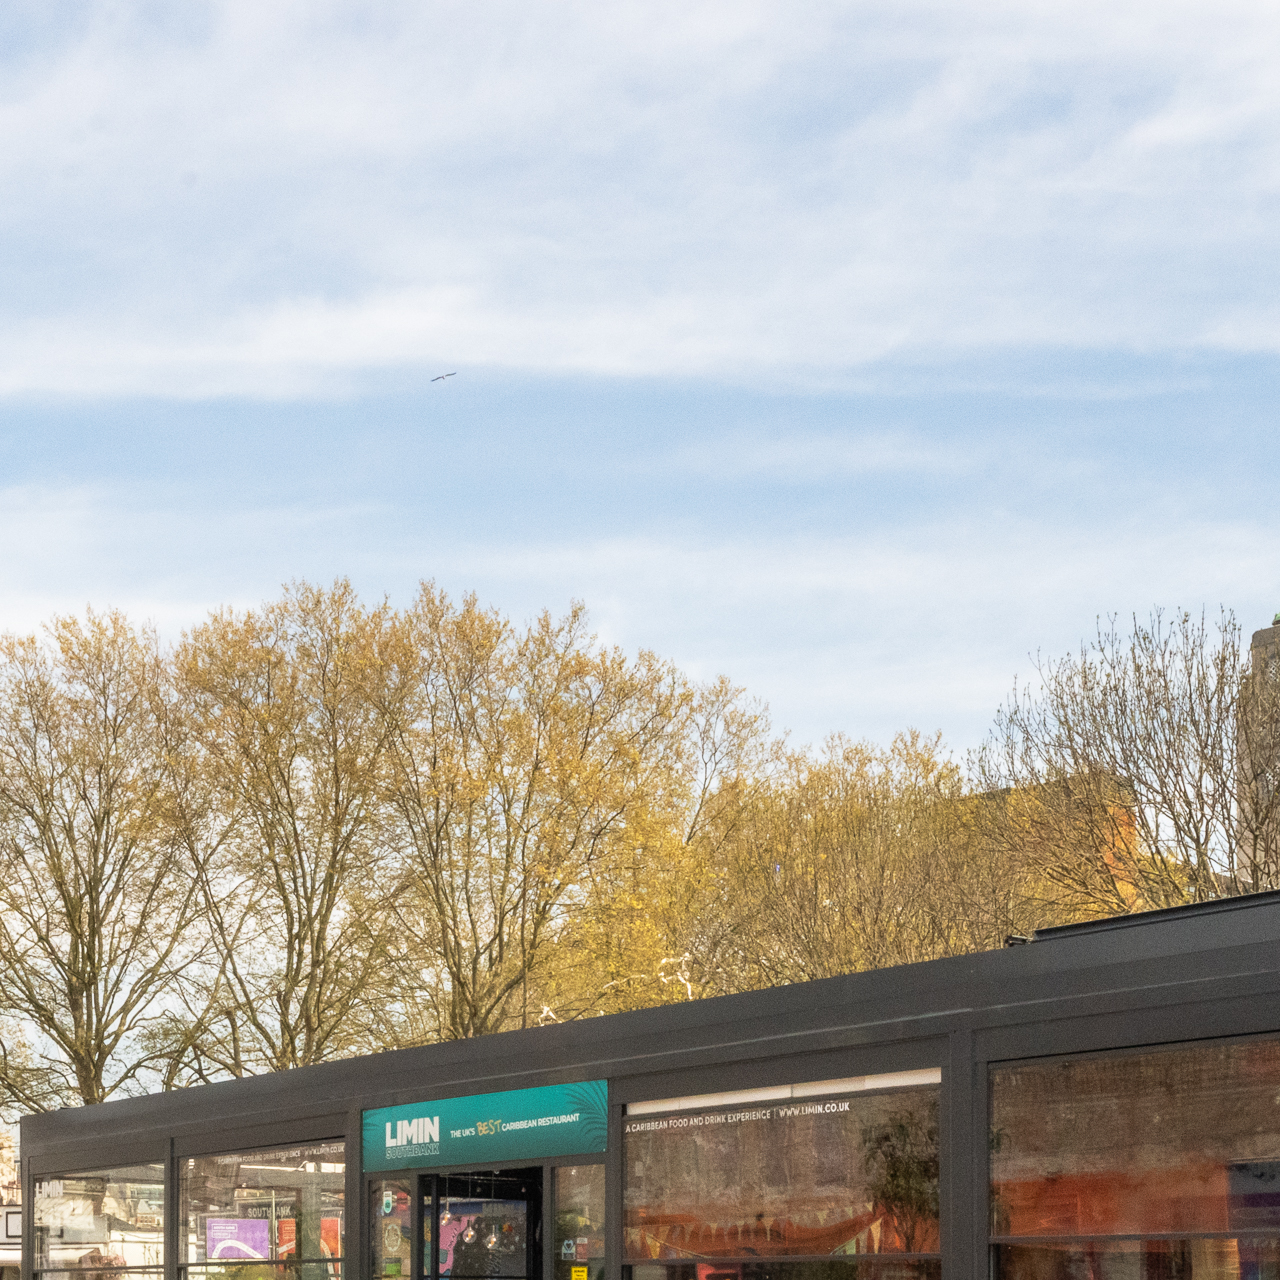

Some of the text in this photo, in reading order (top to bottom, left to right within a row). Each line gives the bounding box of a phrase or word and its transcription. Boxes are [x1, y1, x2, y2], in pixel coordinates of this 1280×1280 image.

[385, 1116, 440, 1148] LIMIN
[450, 1129, 461, 1139] THE
[476, 1119, 502, 1136] BEST
[502, 1119, 538, 1132] CARIBBEAN
[538, 1113, 580, 1127] RESTAURANT
[631, 1121, 668, 1132] CARIBBEAN
[669, 1118, 688, 1129] FOOD
[689, 1117, 704, 1127] AND
[705, 1115, 727, 1126] DRINK
[727, 1110, 771, 1124] EXPERIENCE
[385, 1143, 440, 1160] SOUTHBANK
[275, 1205, 292, 1217] ANK
